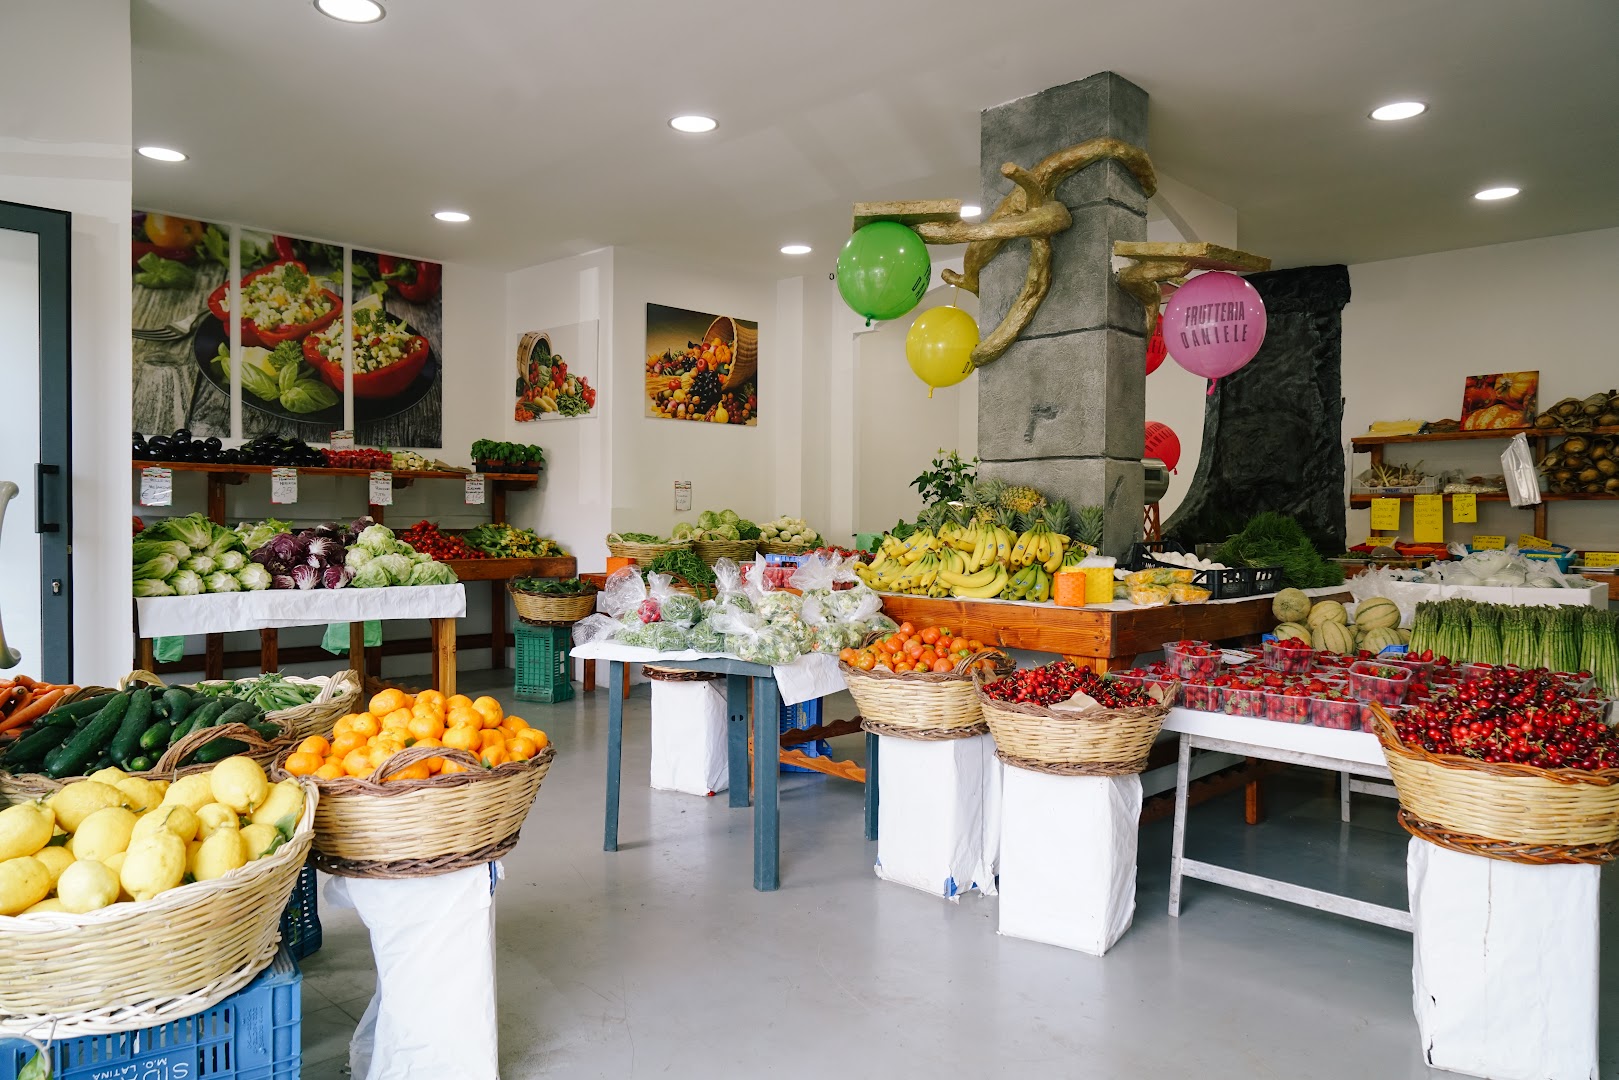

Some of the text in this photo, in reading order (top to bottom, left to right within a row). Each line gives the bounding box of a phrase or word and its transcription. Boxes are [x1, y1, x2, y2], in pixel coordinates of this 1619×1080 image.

[1185, 301, 1245, 327] FRUTTERIA
[1180, 324, 1248, 349] DANIELE
[92, 1057, 167, 1080] M.O. LATINA
